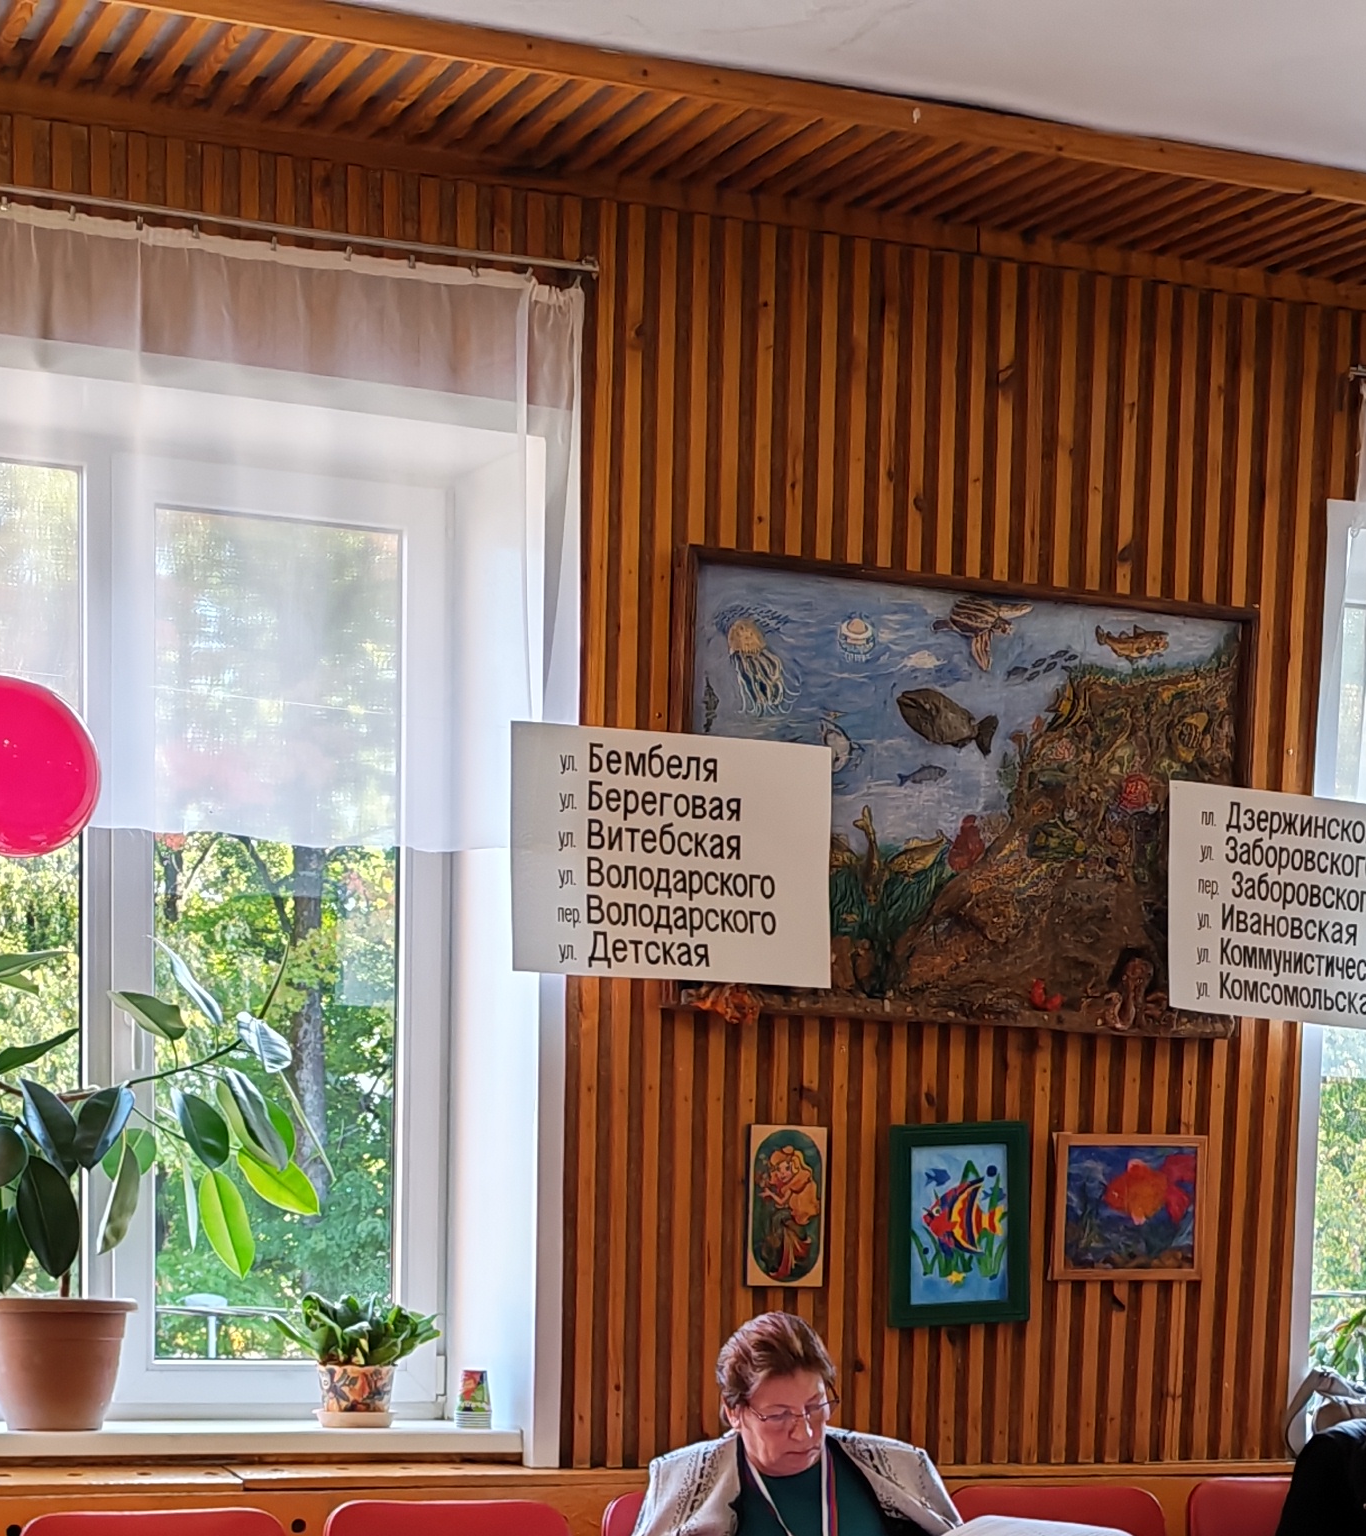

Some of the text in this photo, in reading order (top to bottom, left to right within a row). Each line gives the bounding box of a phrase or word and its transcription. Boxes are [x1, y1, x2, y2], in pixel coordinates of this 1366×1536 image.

[560, 743, 718, 782] ул. Бембеля
[559, 781, 741, 821] ул. Береговая
[1202, 811, 1216, 826] пл.
[559, 819, 741, 860] ул. Витебская
[1199, 845, 1214, 862] ул.
[558, 857, 775, 900] ул. Володарского
[1198, 879, 1219, 899] пер.
[558, 894, 776, 937] пер. Володарского
[1198, 903, 1359, 946] ул. Ивановская
[559, 931, 710, 968] ул. Детская
[1197, 947, 1210, 965] ул.
[1196, 982, 1210, 1000] ул.
